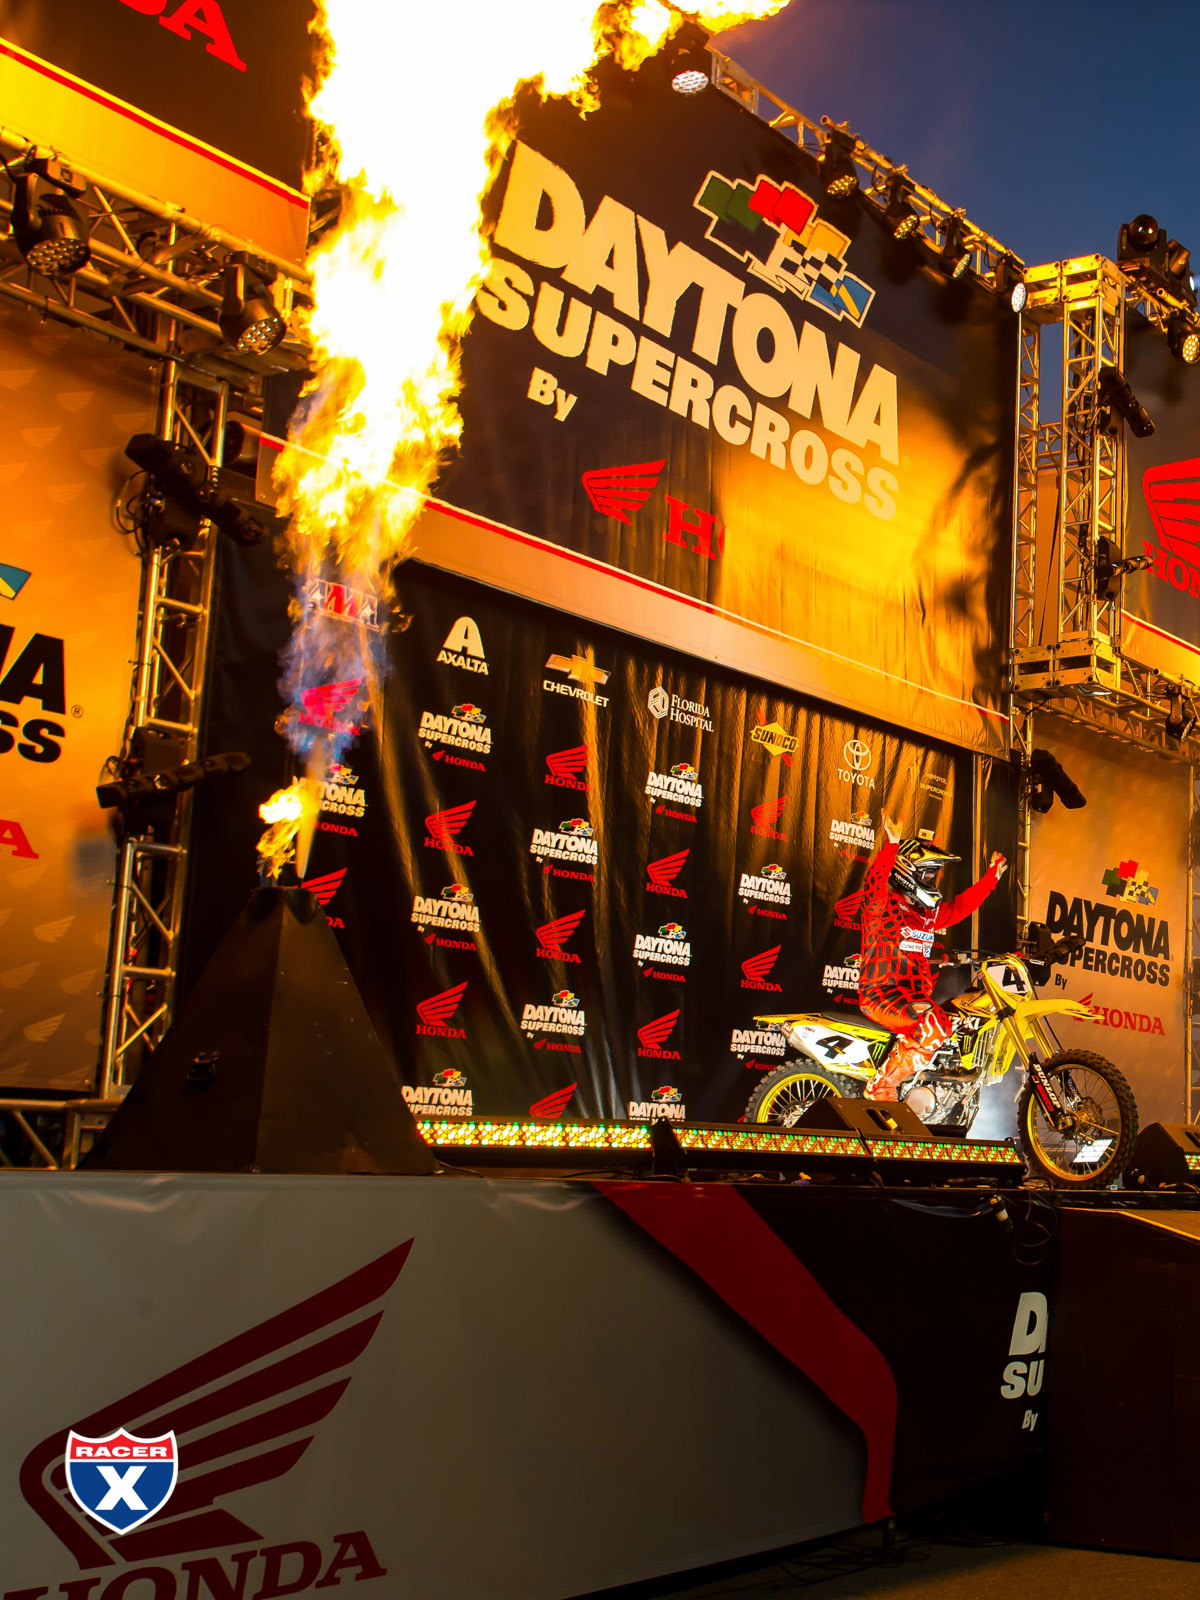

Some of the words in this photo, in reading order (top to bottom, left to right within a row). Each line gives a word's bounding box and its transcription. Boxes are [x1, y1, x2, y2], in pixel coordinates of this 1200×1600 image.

[494, 140, 899, 466] DAYTONA
[475, 257, 899, 521] SUPERCROSS
[527, 367, 577, 422] By
[436, 649, 489, 675] AXALTA
[543, 680, 609, 708] CHEVROLET
[670, 694, 710, 718] FLORIDA
[420, 711, 492, 745] DAYTONA
[669, 707, 714, 732] HOSPITAL
[418, 727, 491, 754] SUPERCROSS
[752, 728, 797, 751] SUNOCO
[444, 755, 486, 772] HONDA
[544, 775, 591, 792] HOND
[647, 772, 703, 798] DAYTONA
[837, 768, 876, 790] TOYOTA
[645, 786, 702, 807] SUPERCROSS
[665, 809, 697, 823] HONDA
[750, 825, 787, 841] HONDA
[831, 819, 875, 842] DAYTONA
[424, 837, 474, 857] HONDA
[532, 829, 598, 855] DAYTONA
[829, 832, 875, 850] SUPERCROSS
[530, 844, 598, 865] SUPERCROSS
[552, 869, 594, 882] HONDA
[739, 874, 791, 897] DAYTONA
[645, 883, 688, 899] HONDA
[738, 888, 791, 905] SUPERCROSS
[413, 896, 480, 922] DAYTONA
[757, 909, 787, 920] HONDA
[411, 912, 480, 932] SUPERCROSS
[834, 918, 861, 930] HOND
[1045, 890, 1170, 961] DAYTONA
[436, 937, 477, 951] HONDA
[635, 934, 691, 957] DAYTONA
[912, 930, 935, 941] SUZUK
[536, 948, 581, 963] HONDA
[633, 949, 690, 966] SUPERCROSS
[823, 965, 860, 982] DAYTO
[1055, 946, 1171, 987] PERCROSS
[652, 971, 686, 983] HONDA
[740, 980, 783, 992] HONDA
[822, 978, 859, 990] SUPERCR
[1002, 966, 1026, 991] 4
[1054, 973, 1067, 990] By
[523, 1004, 585, 1026] DAYTONA
[1093, 1005, 1166, 1036] HONDA
[416, 1024, 467, 1039] HONDA
[520, 1020, 585, 1036] SUPERCROSS
[732, 1029, 786, 1047] DAYTONA
[546, 1042, 581, 1053] HONDA
[637, 1048, 682, 1060] HONDA
[730, 1043, 785, 1056] SUPERCROSS
[815, 1035, 854, 1059] 4
[401, 1086, 473, 1106] DAYTONA
[1033, 1064, 1061, 1109] DUNLOP
[629, 1101, 686, 1119] DAYTONA
[1022, 1409, 1038, 1432] By
